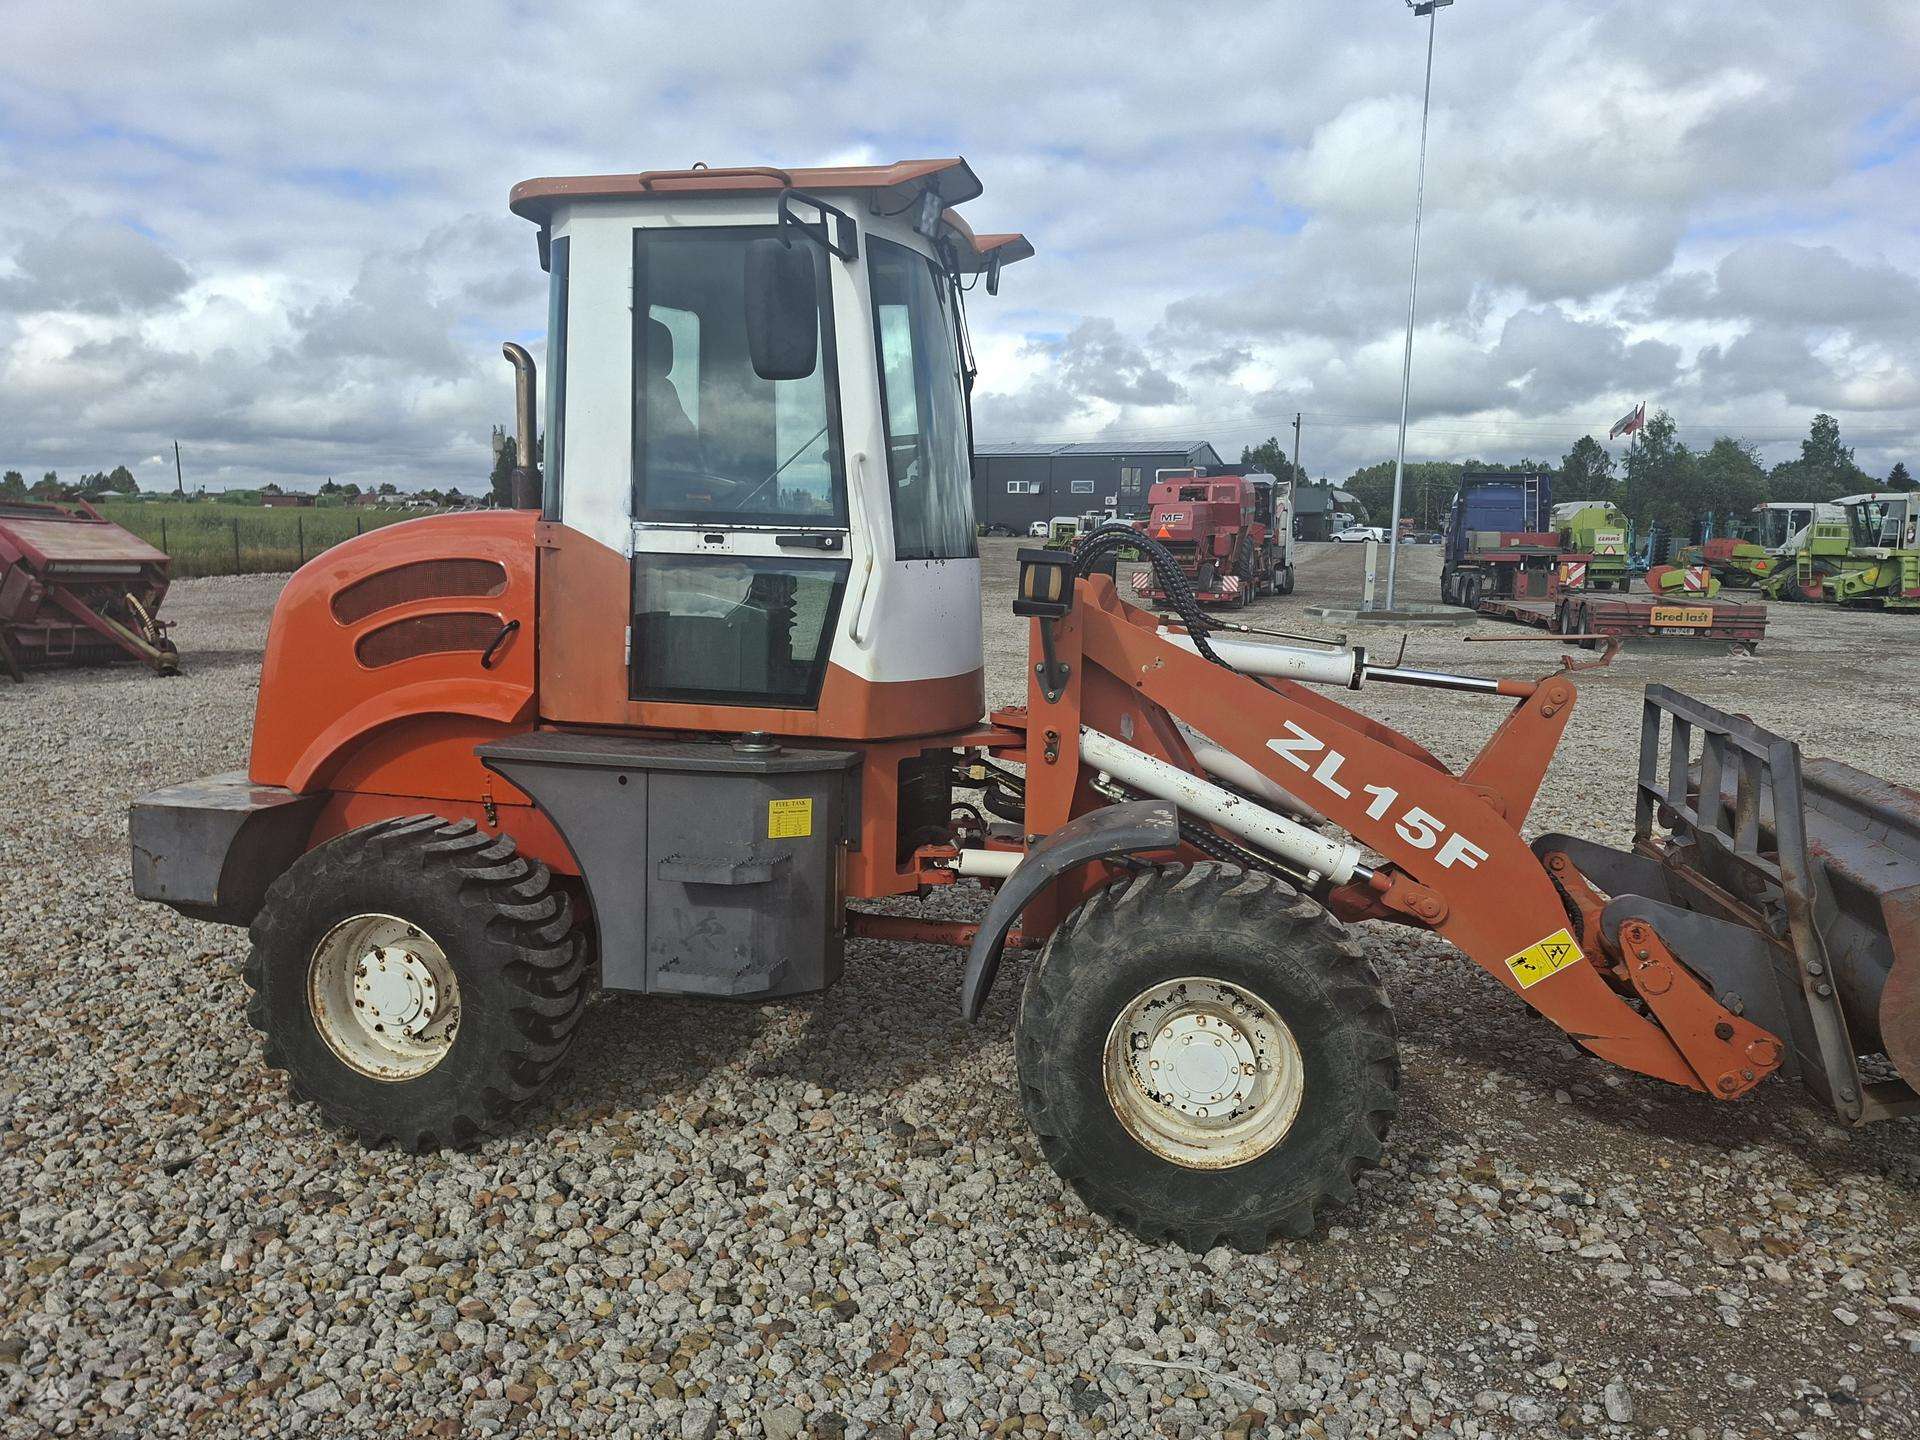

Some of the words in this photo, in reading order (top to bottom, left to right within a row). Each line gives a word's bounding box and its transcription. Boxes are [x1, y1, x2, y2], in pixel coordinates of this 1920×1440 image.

[1161, 514, 1184, 522] MF
[1655, 612, 1683, 621] Bred
[1686, 612, 1708, 622] last
